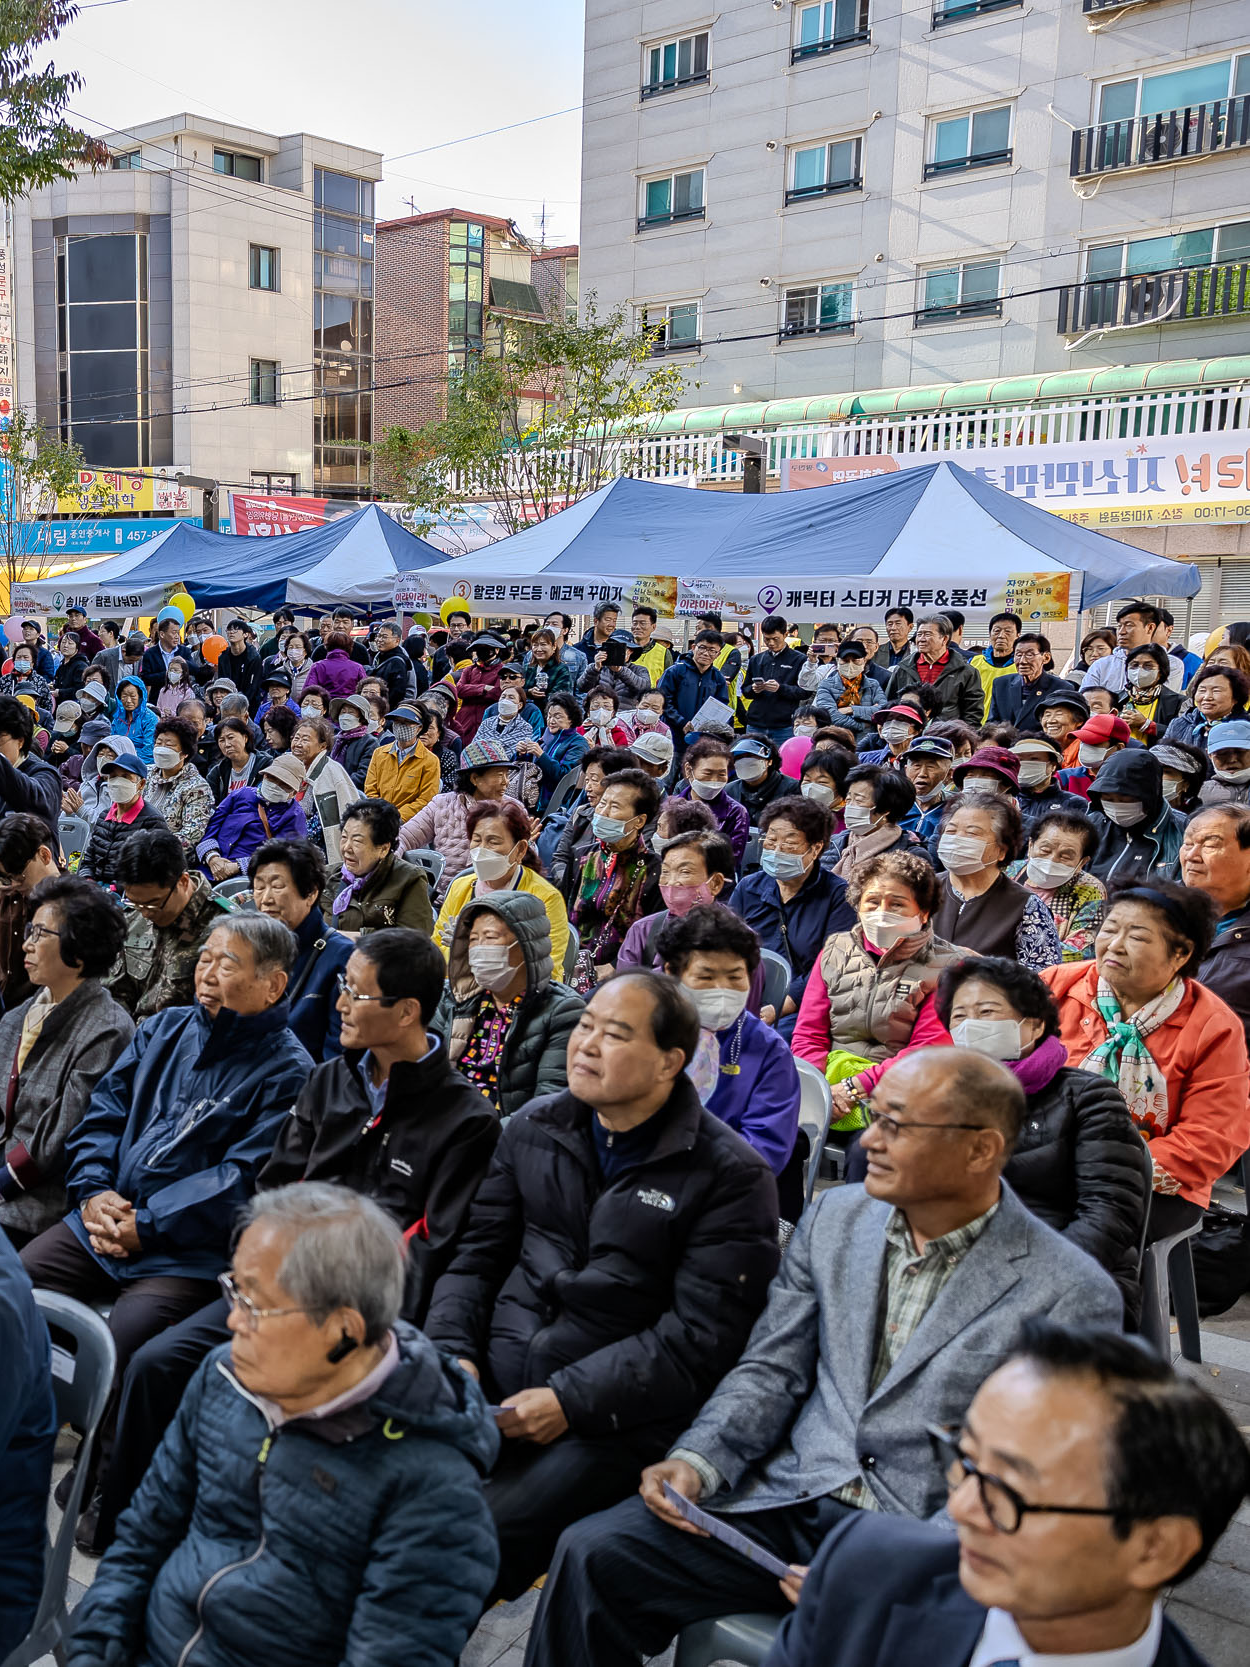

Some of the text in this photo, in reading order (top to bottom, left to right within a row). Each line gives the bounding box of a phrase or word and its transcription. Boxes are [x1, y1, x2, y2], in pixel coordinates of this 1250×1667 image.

[77, 494, 136, 510] 생활과학
[70, 528, 111, 539] 공인중개사
[1006, 579, 1038, 587] 자양1동
[458, 584, 466, 598] 3
[587, 585, 623, 602] 꾸미기
[1005, 588, 1032, 597] 신나는
[53, 594, 61, 606] 4
[113, 595, 143, 608] 나눠요!
[765, 590, 775, 605] 2
[786, 588, 988, 608] 캐릭터 스티커 타투&풍선
[1005, 598, 1032, 606] 만들기
[680, 599, 724, 610] 이랴이랴!
